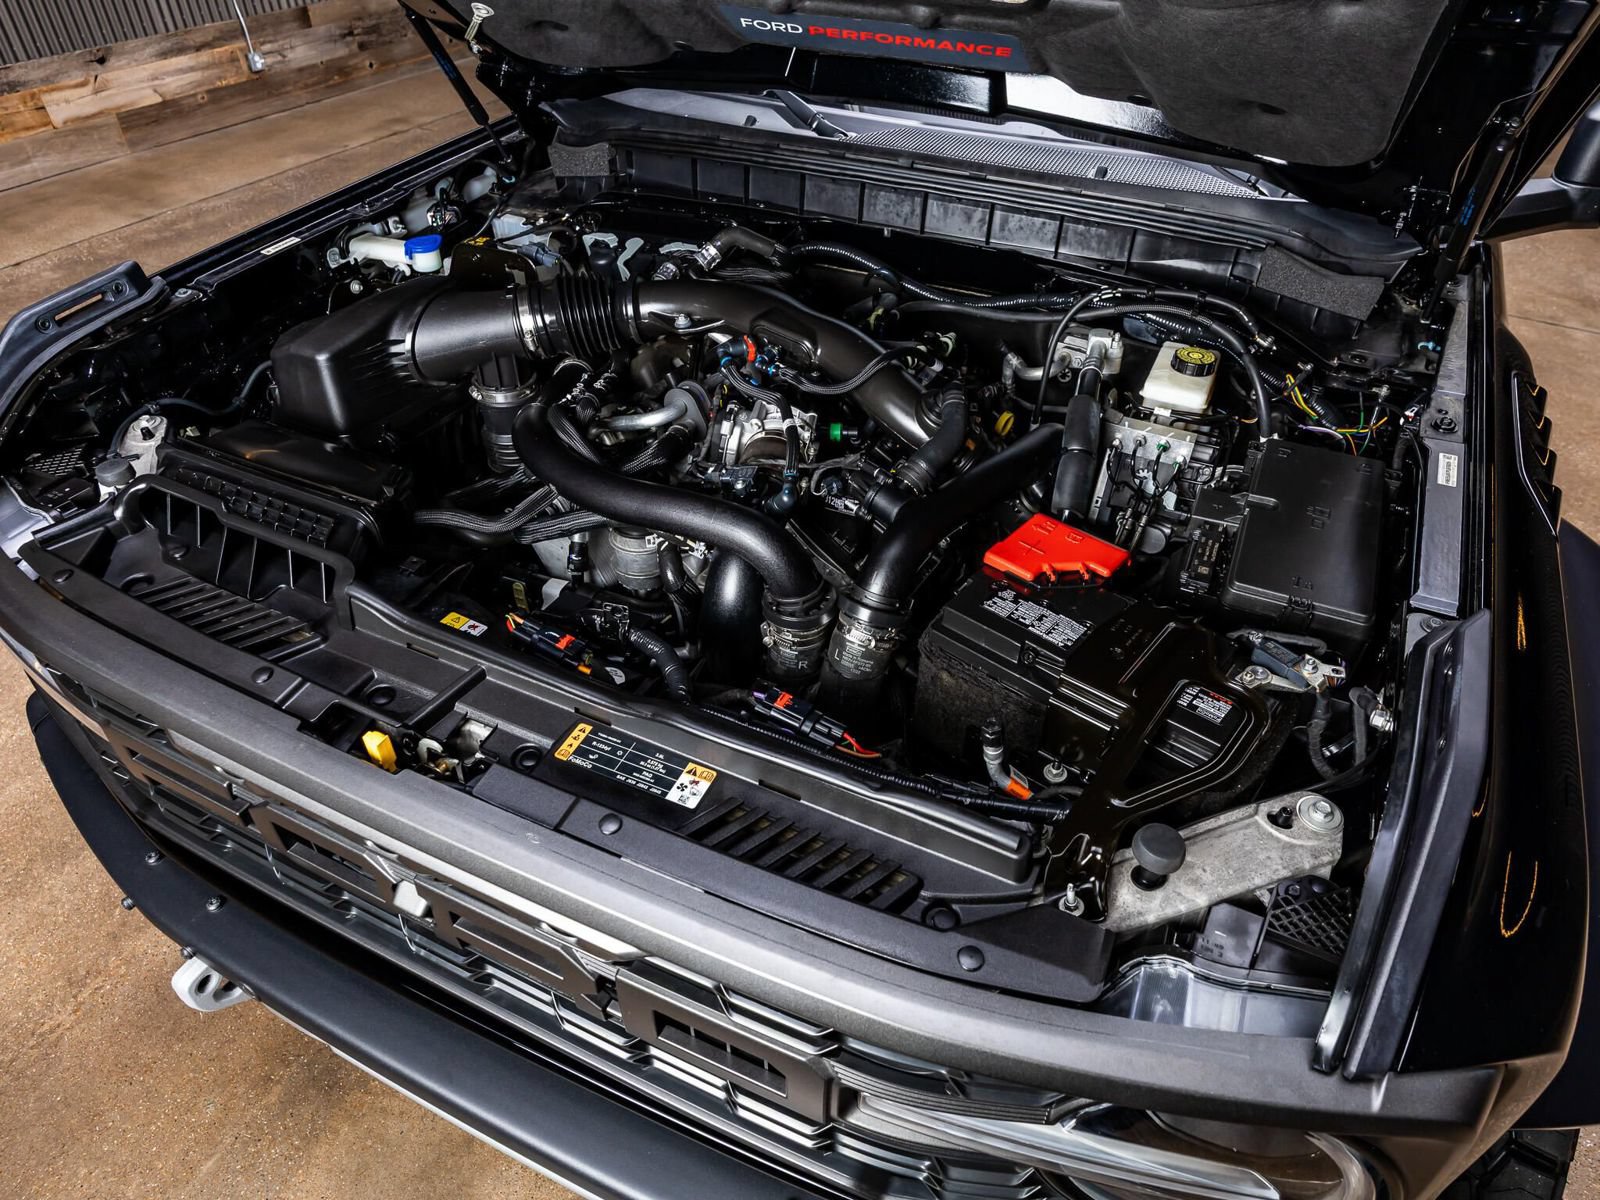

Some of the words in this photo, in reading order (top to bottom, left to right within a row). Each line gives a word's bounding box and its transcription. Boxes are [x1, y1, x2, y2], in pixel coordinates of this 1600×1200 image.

[739, 17, 803, 35] FORD
[807, 24, 1013, 58] PERFORMANCE
[834, 648, 840, 661] L
[798, 660, 808, 670] R
[568, 755, 593, 769] FoMoCo
